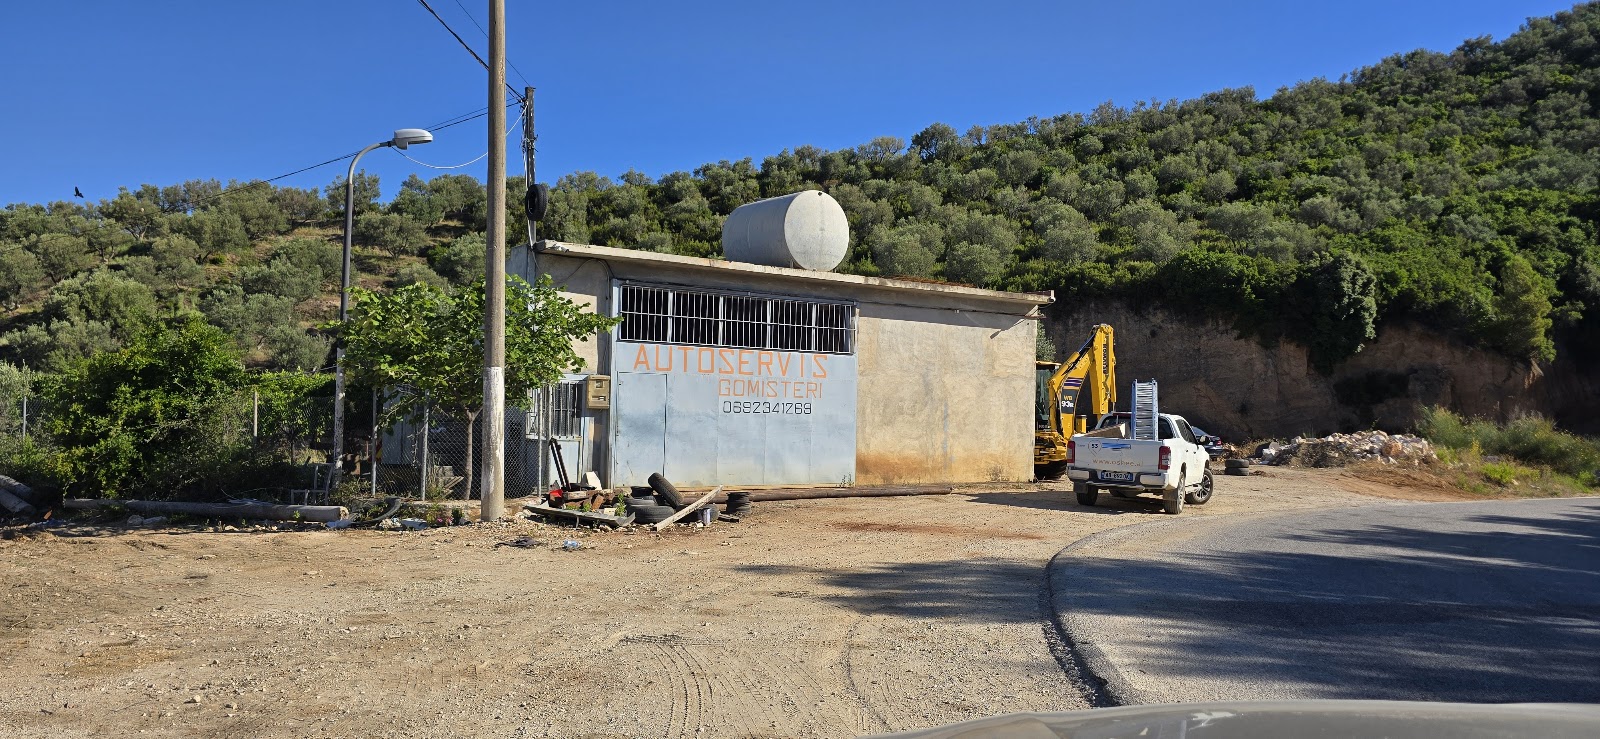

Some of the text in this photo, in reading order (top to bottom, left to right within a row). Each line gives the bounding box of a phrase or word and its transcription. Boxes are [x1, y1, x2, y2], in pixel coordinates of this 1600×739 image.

[633, 343, 828, 378] AUTOSERVIS
[718, 378, 823, 399] GOMISTERI
[722, 400, 812, 415] 0692341269
